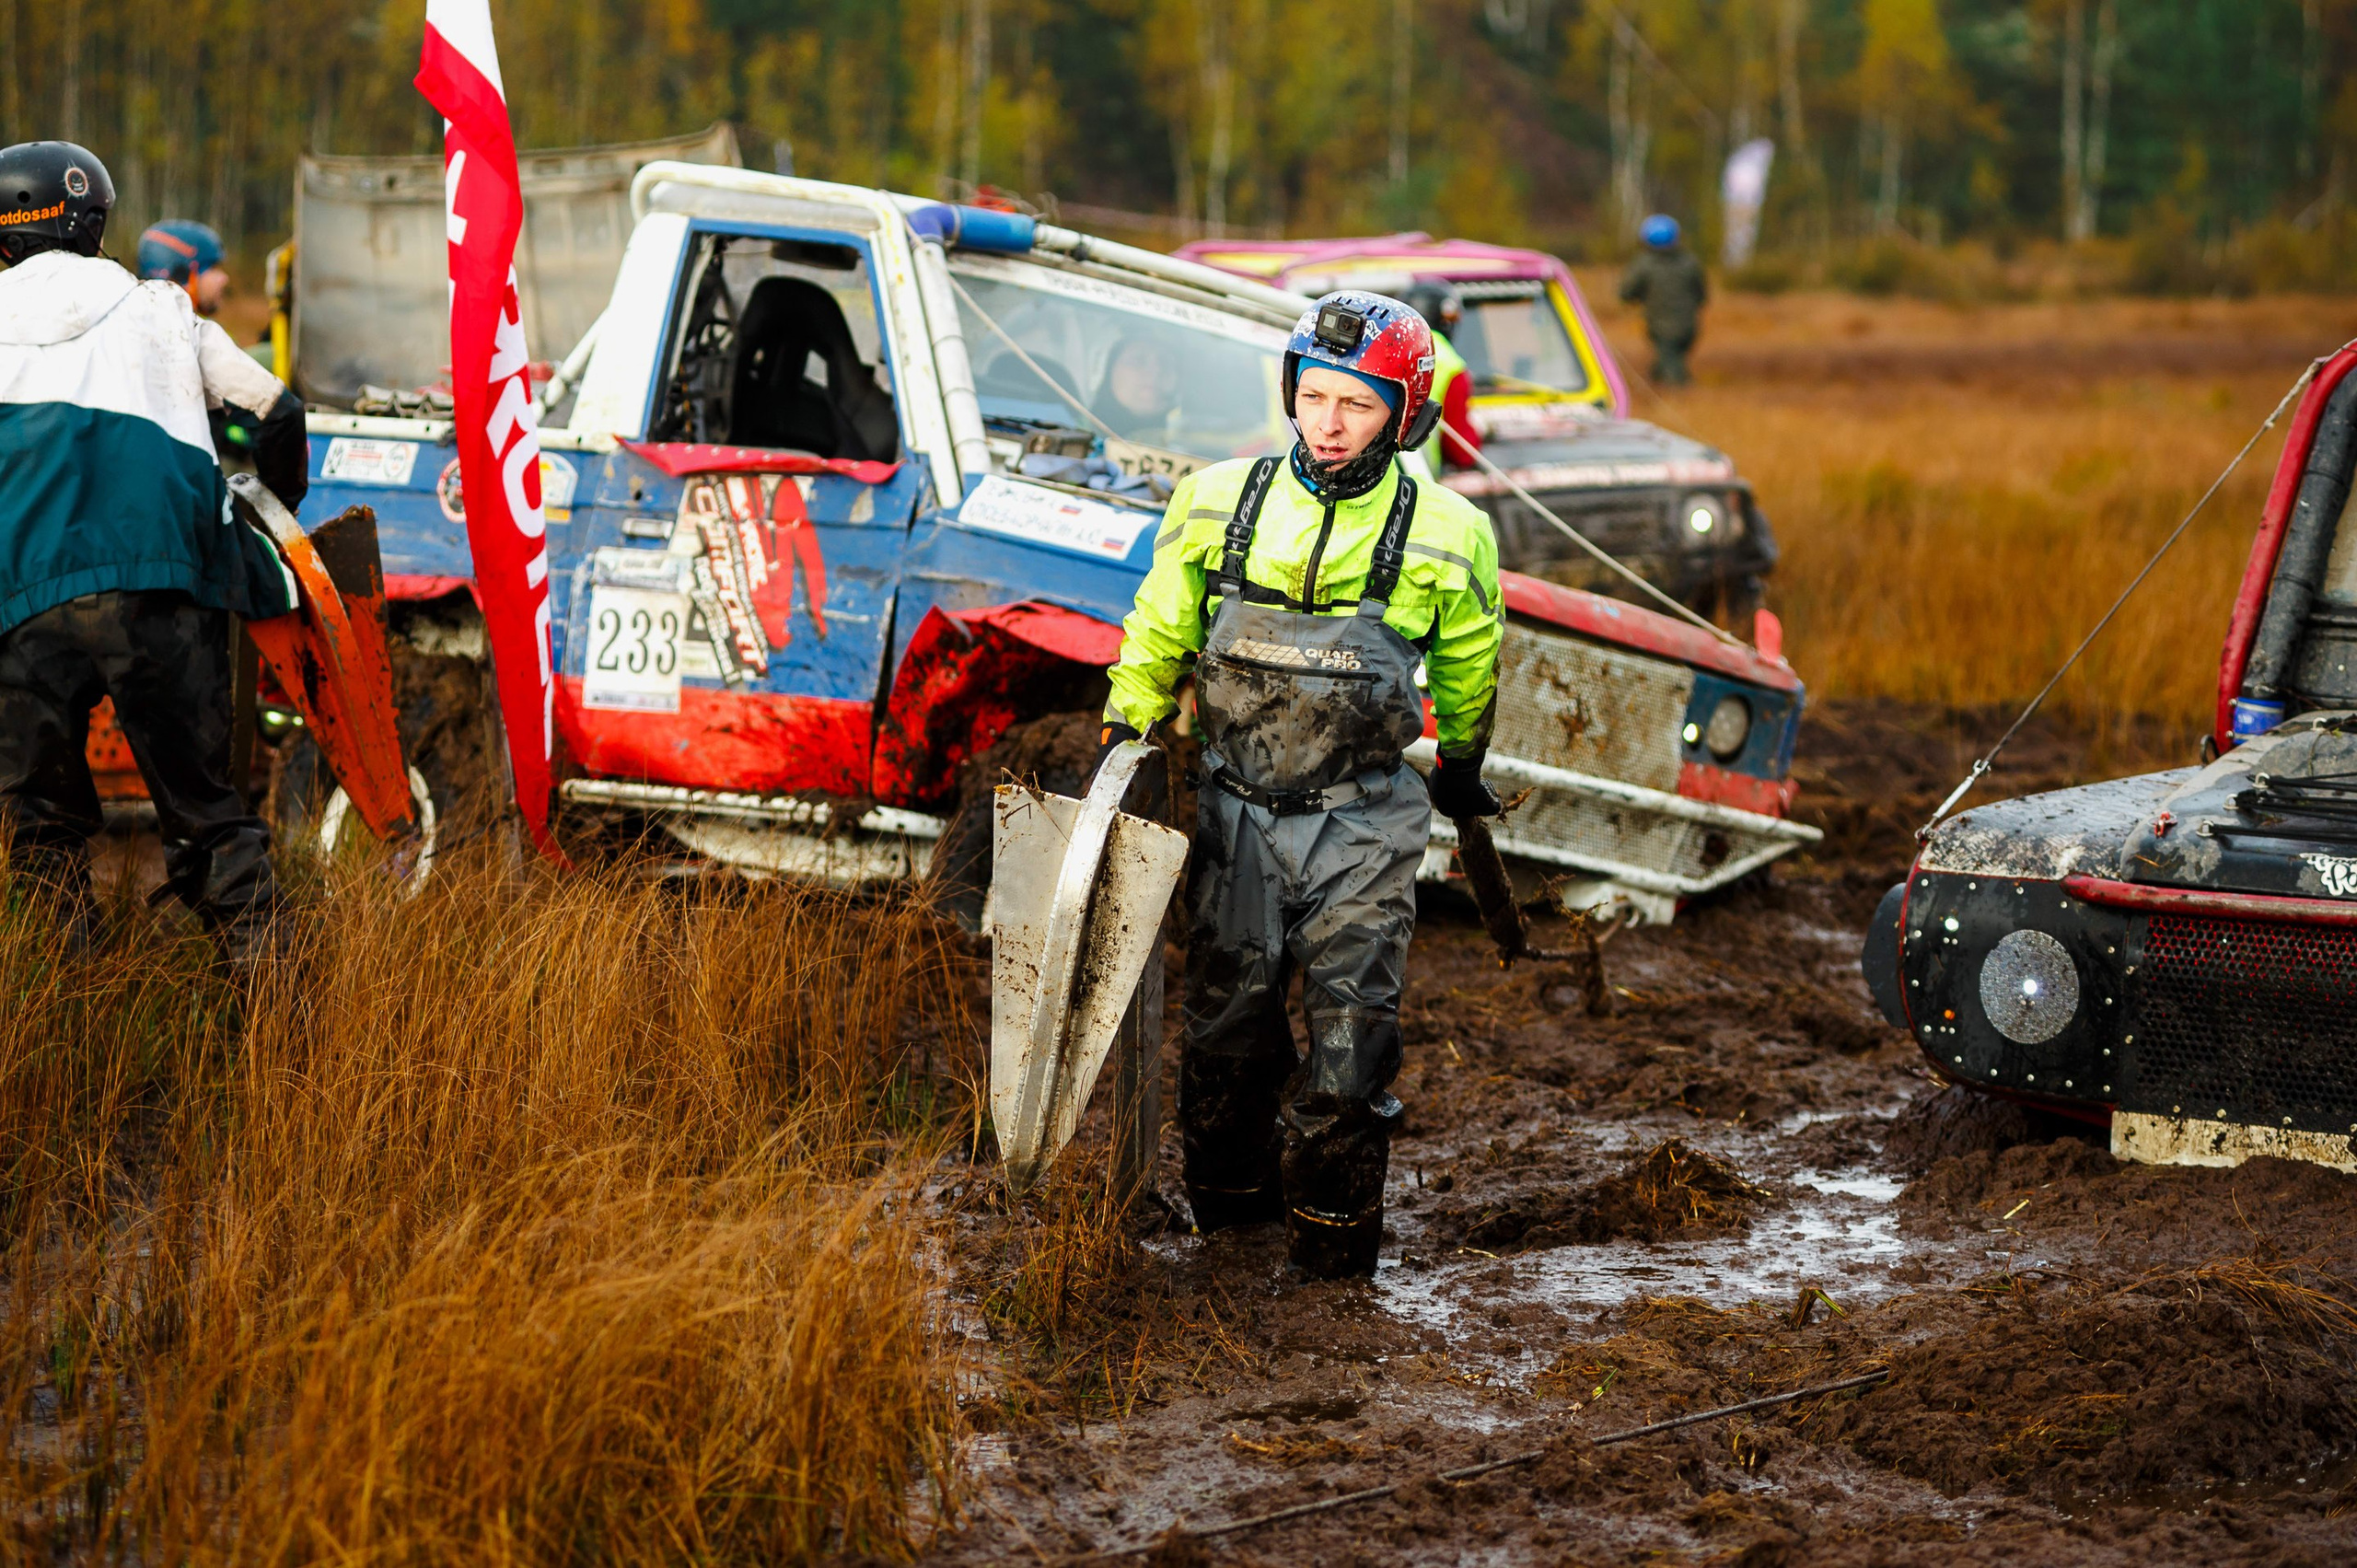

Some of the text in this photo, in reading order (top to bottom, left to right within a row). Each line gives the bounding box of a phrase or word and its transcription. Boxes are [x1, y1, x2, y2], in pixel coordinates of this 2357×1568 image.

[0, 200, 65, 226] otdosaaf
[598, 608, 679, 675] 233
[1305, 648, 1355, 660] QUAD
[1320, 658, 1361, 671] PRO
